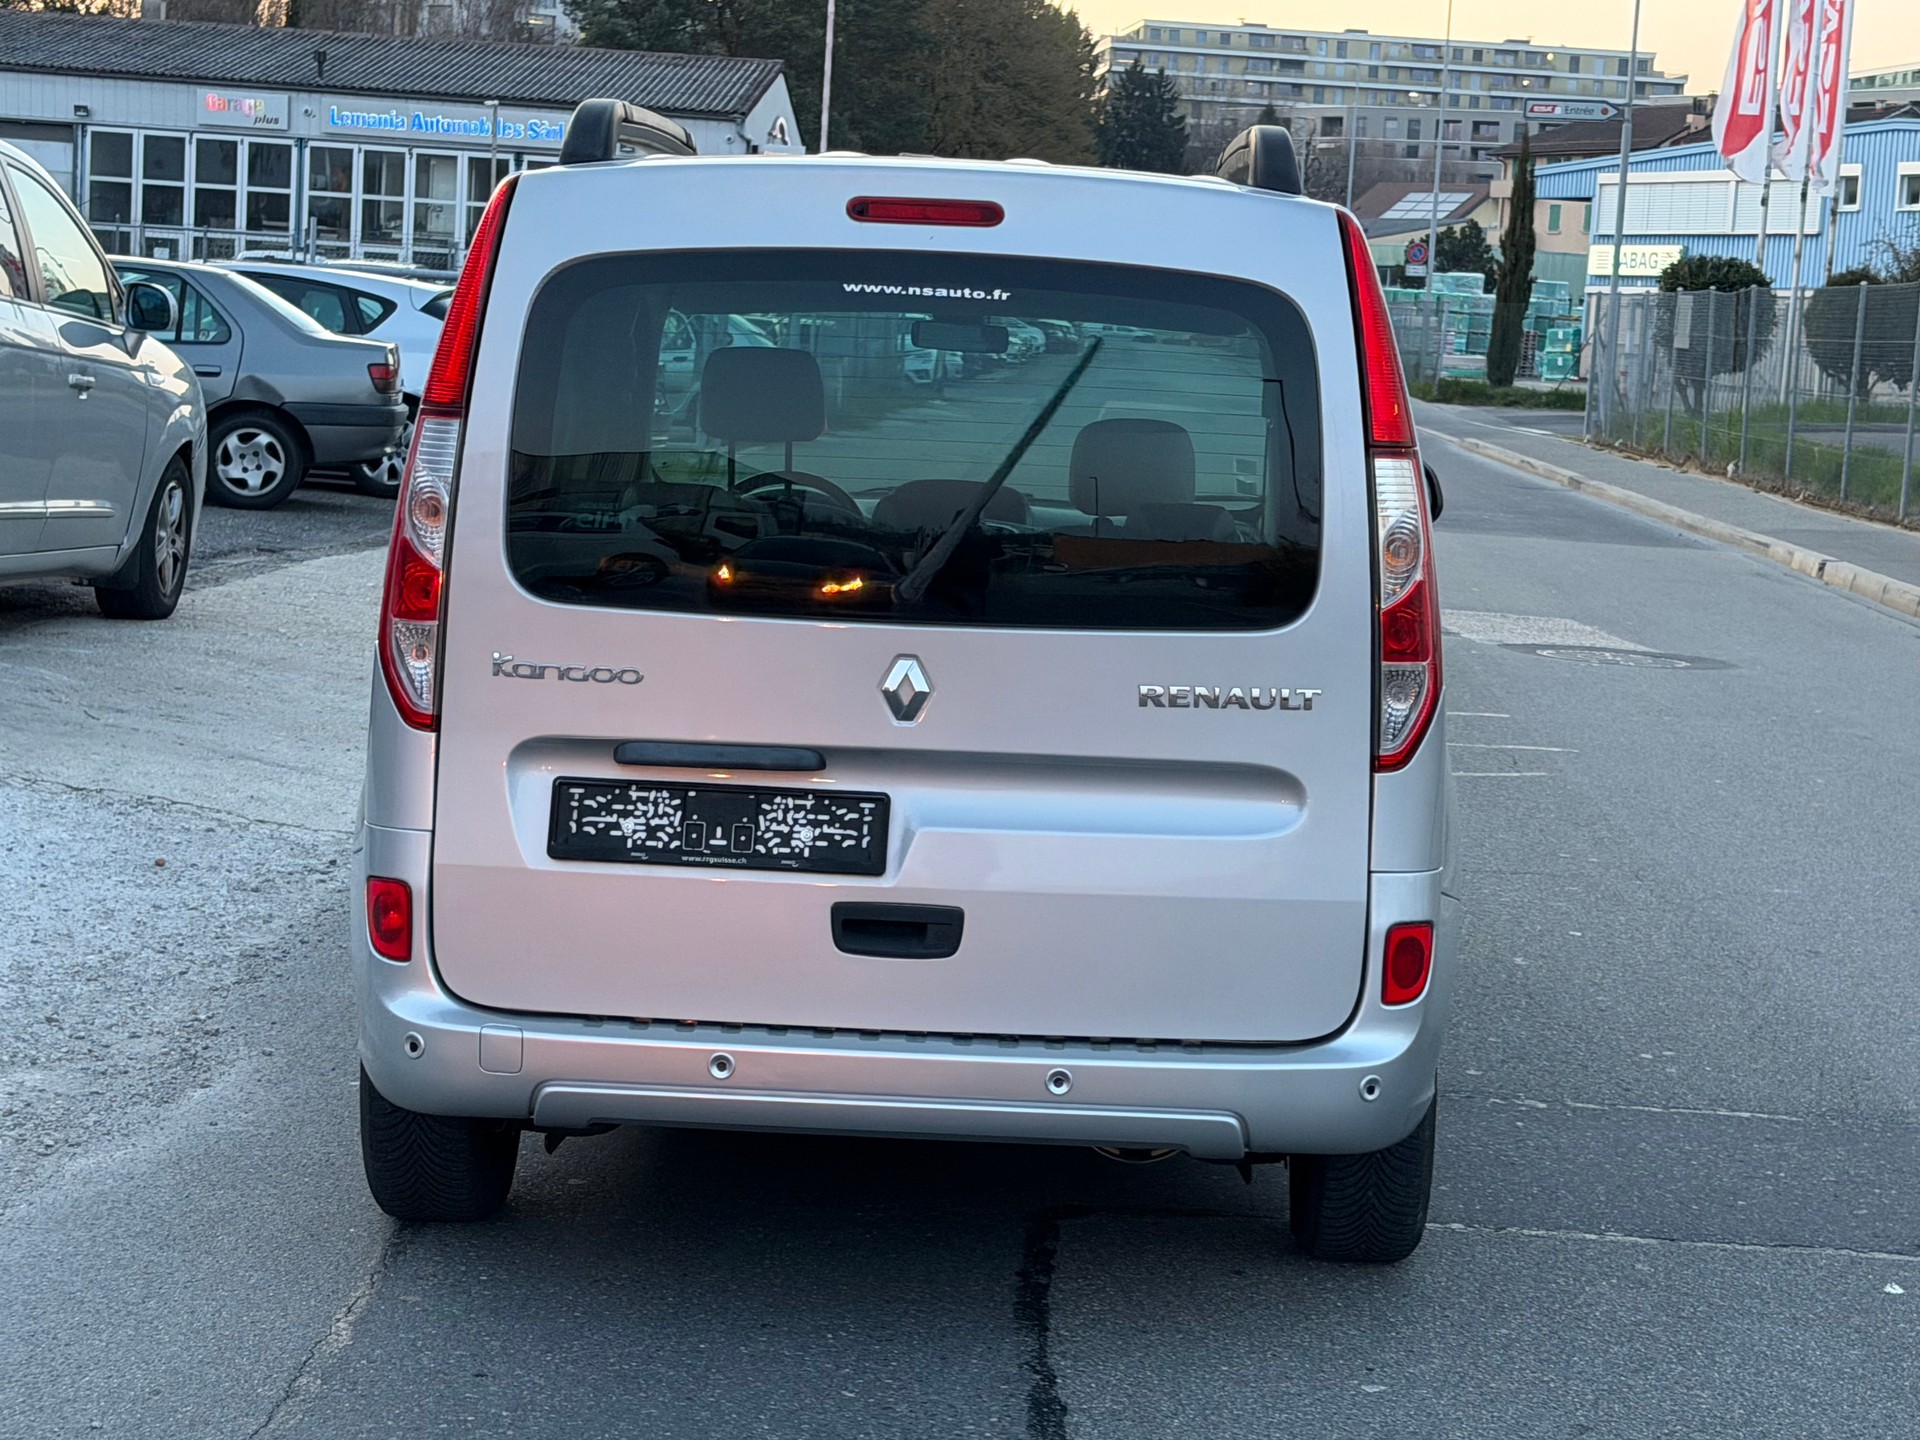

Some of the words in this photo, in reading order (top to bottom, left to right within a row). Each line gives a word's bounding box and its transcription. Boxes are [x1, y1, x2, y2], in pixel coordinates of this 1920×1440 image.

[253, 114, 280, 126] plus
[329, 106, 407, 131] Lemania
[411, 112, 525, 139] Automobles
[842, 282, 1012, 301] www.nsauto.fr
[1137, 685, 1323, 711] RENAULT
